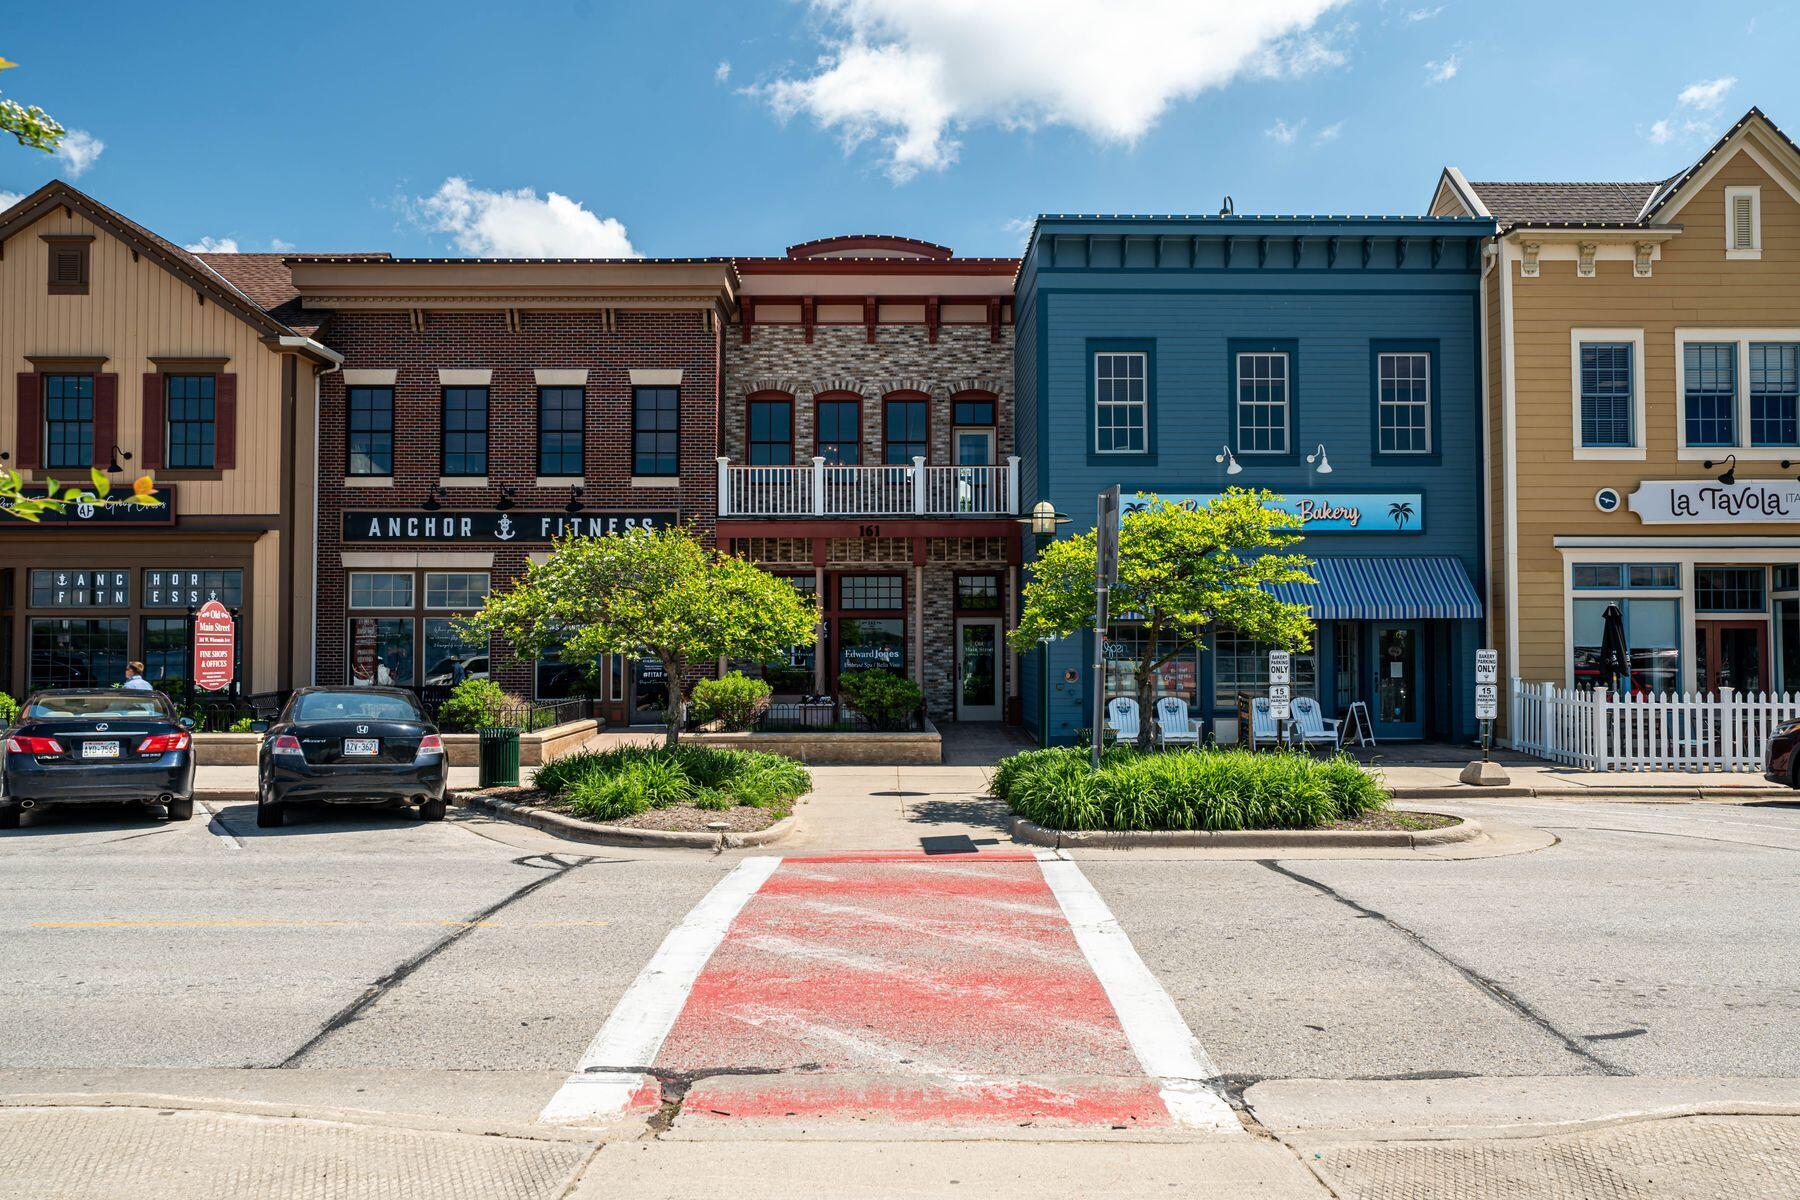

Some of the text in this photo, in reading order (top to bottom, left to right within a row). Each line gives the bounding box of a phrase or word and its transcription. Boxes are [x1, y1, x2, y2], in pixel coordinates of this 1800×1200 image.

[1670, 488, 1699, 516] la
[1699, 487, 1789, 516] Tavola
[1296, 498, 1361, 526] Bakery
[368, 517, 653, 537] ANCHOR FITNESS
[859, 525, 880, 537] 161
[210, 609, 221, 619] Old
[200, 622, 231, 632] Main Street
[211, 650, 228, 658] SHOPS
[845, 649, 900, 659] Edward Jones
[206, 660, 228, 668] OFFICES
